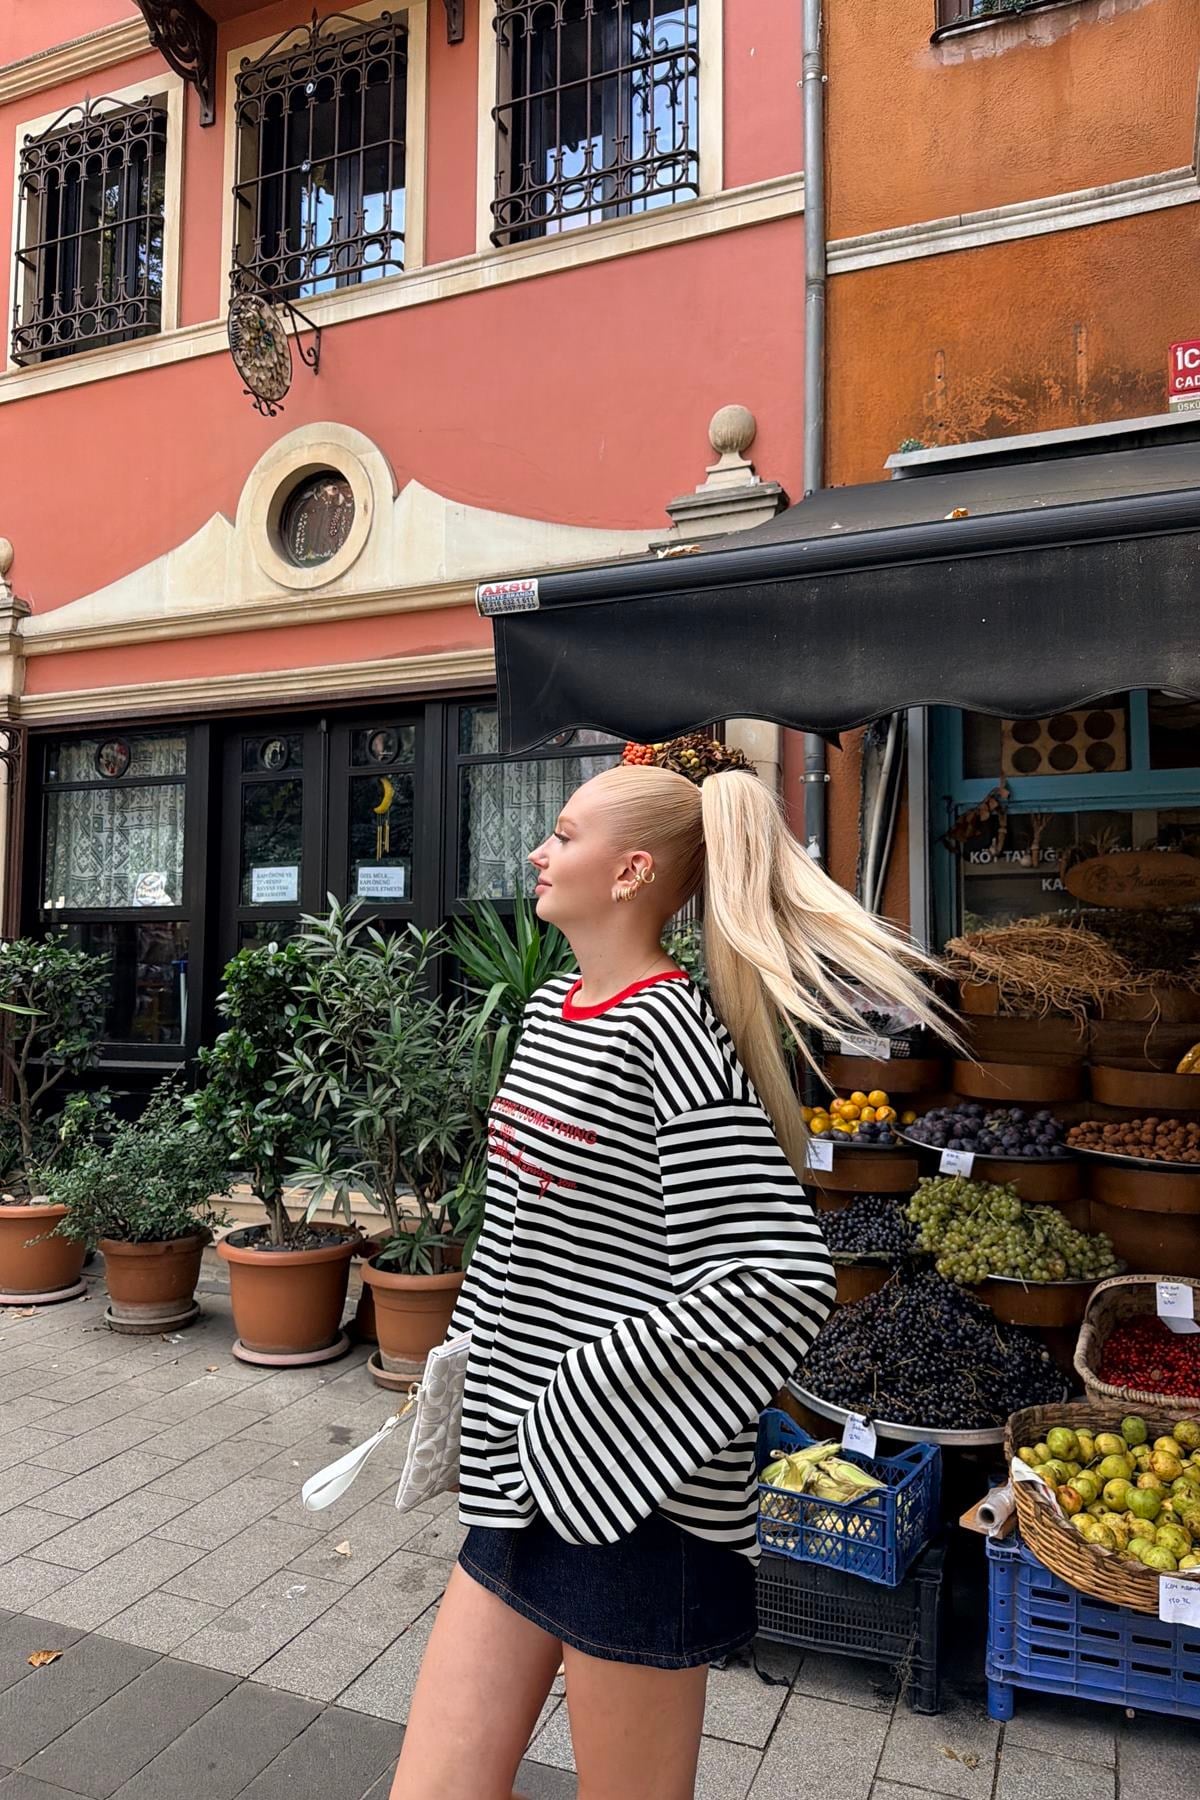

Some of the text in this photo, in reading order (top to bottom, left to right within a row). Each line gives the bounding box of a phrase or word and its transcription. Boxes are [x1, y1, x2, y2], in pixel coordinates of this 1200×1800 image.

[482, 582, 534, 596] AKSU
[970, 849, 997, 864] KÖ
[525, 1110, 597, 1145] SOMETHING
